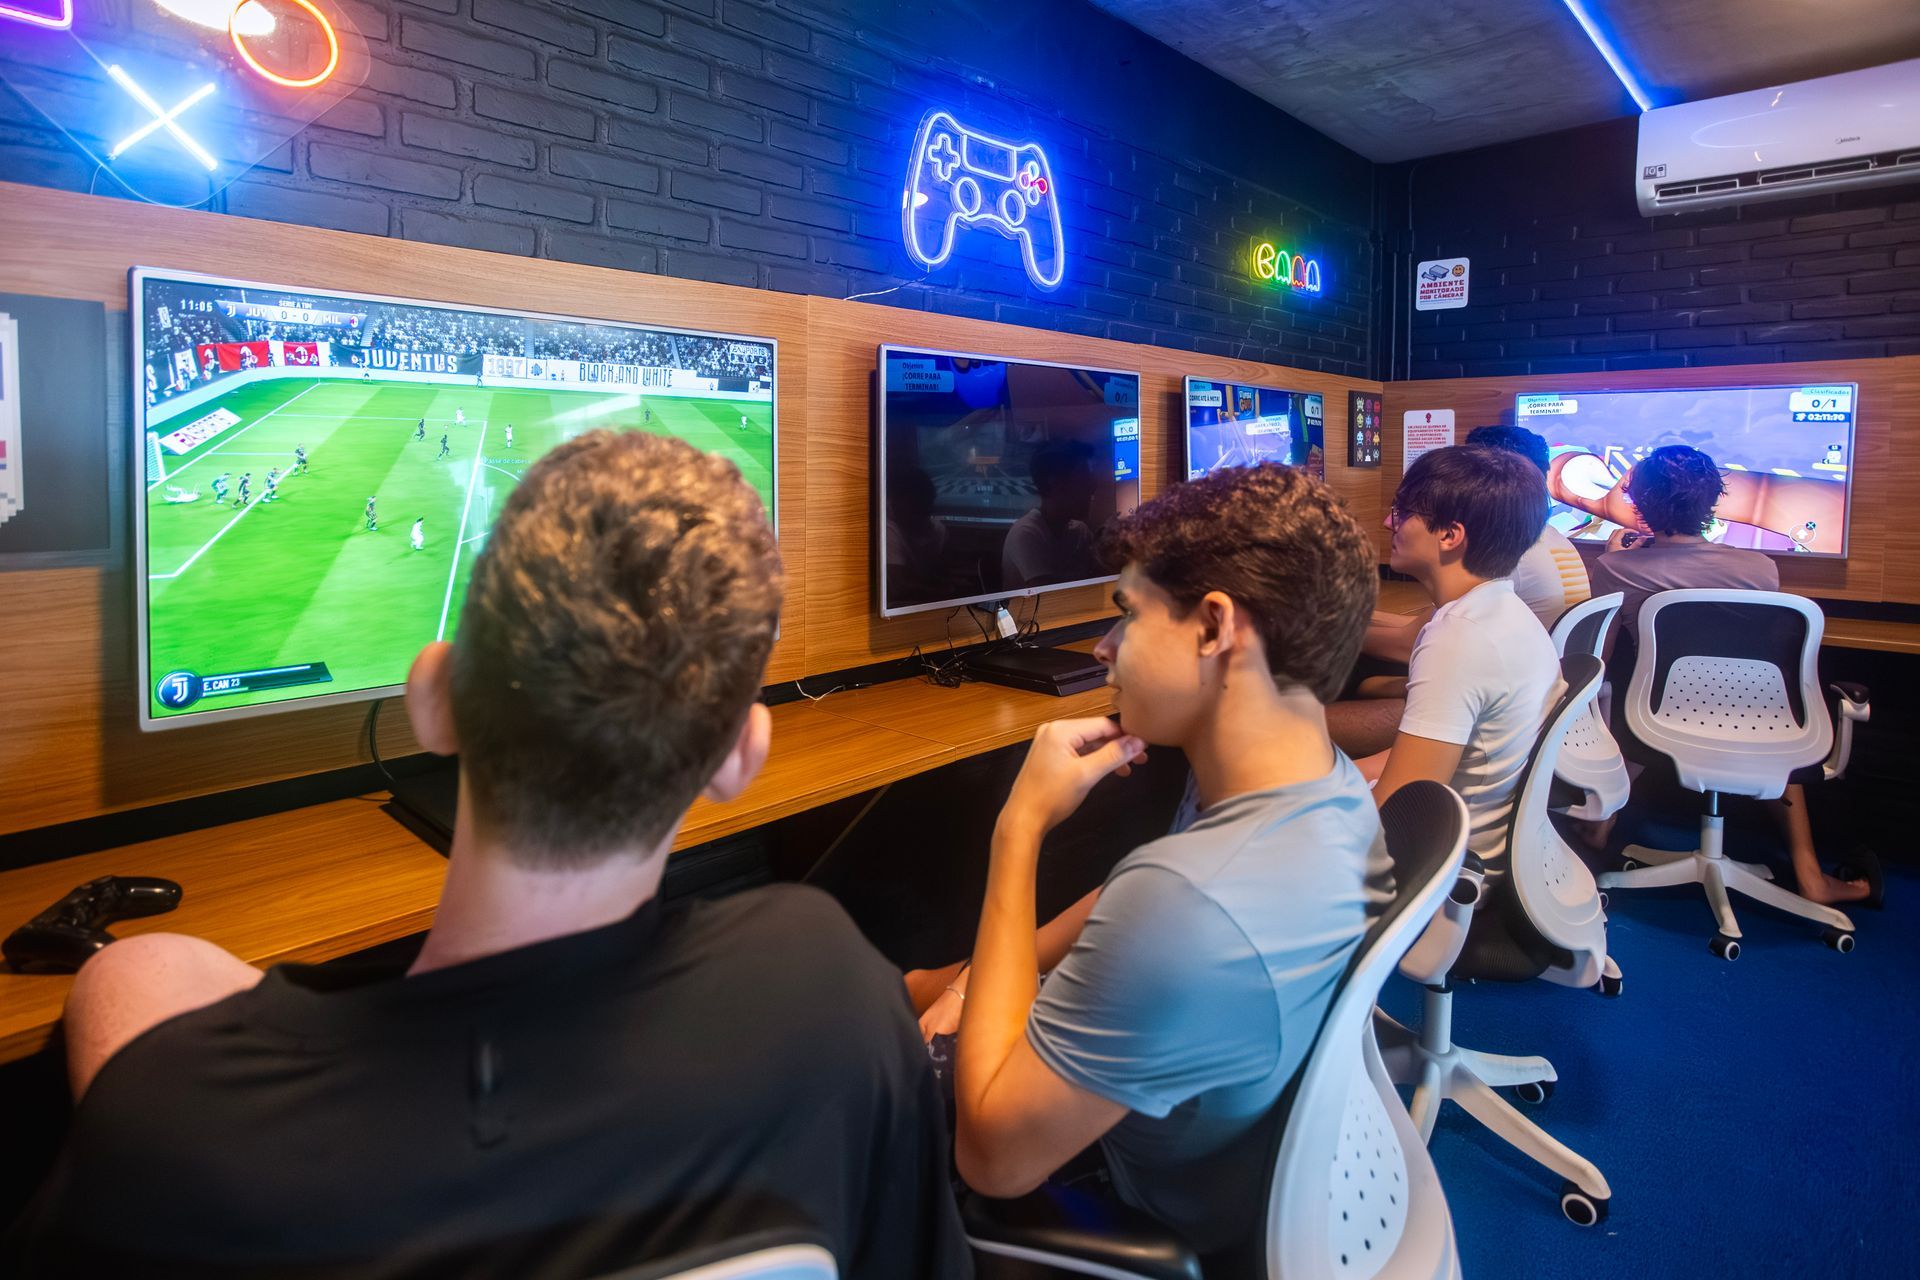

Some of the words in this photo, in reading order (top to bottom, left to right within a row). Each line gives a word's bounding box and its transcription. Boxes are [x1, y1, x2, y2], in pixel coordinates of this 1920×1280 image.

[1421, 280, 1464, 288] AMBIENTE
[246, 306, 267, 318] JUV
[281, 311, 288, 319] 0
[303, 313, 309, 321] 0
[322, 314, 342, 325] MIL
[361, 349, 458, 373] JUVENTUS
[618, 365, 638, 384] AND
[1812, 399, 1837, 409] 0/1
[213, 679, 229, 690] CAN
[231, 678, 240, 687] 23
